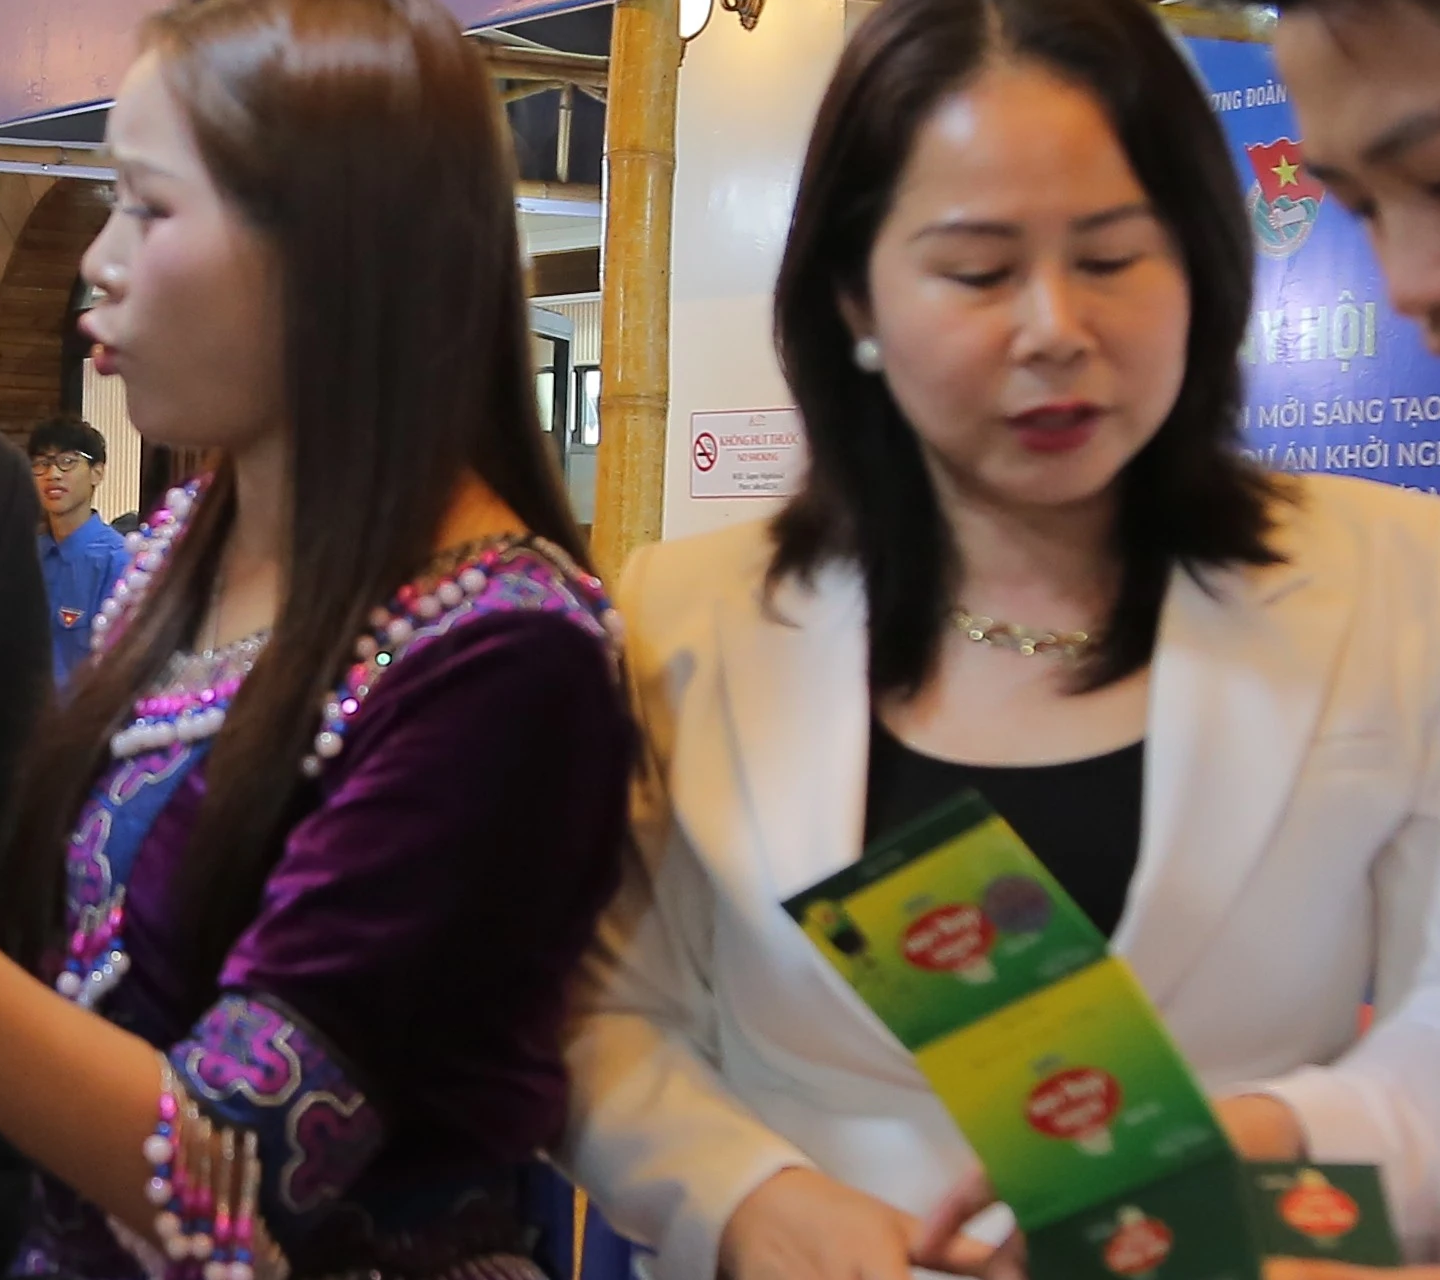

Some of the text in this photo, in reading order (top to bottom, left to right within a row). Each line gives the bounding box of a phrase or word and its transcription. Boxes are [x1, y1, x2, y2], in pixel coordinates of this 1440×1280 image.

[1246, 80, 1287, 108] ĐOÀN
[1300, 290, 1376, 373] HỘI
[1312, 394, 1384, 427] SÁNG
[1282, 440, 1317, 470] ÁN
[1326, 435, 1389, 468] KHỞI
